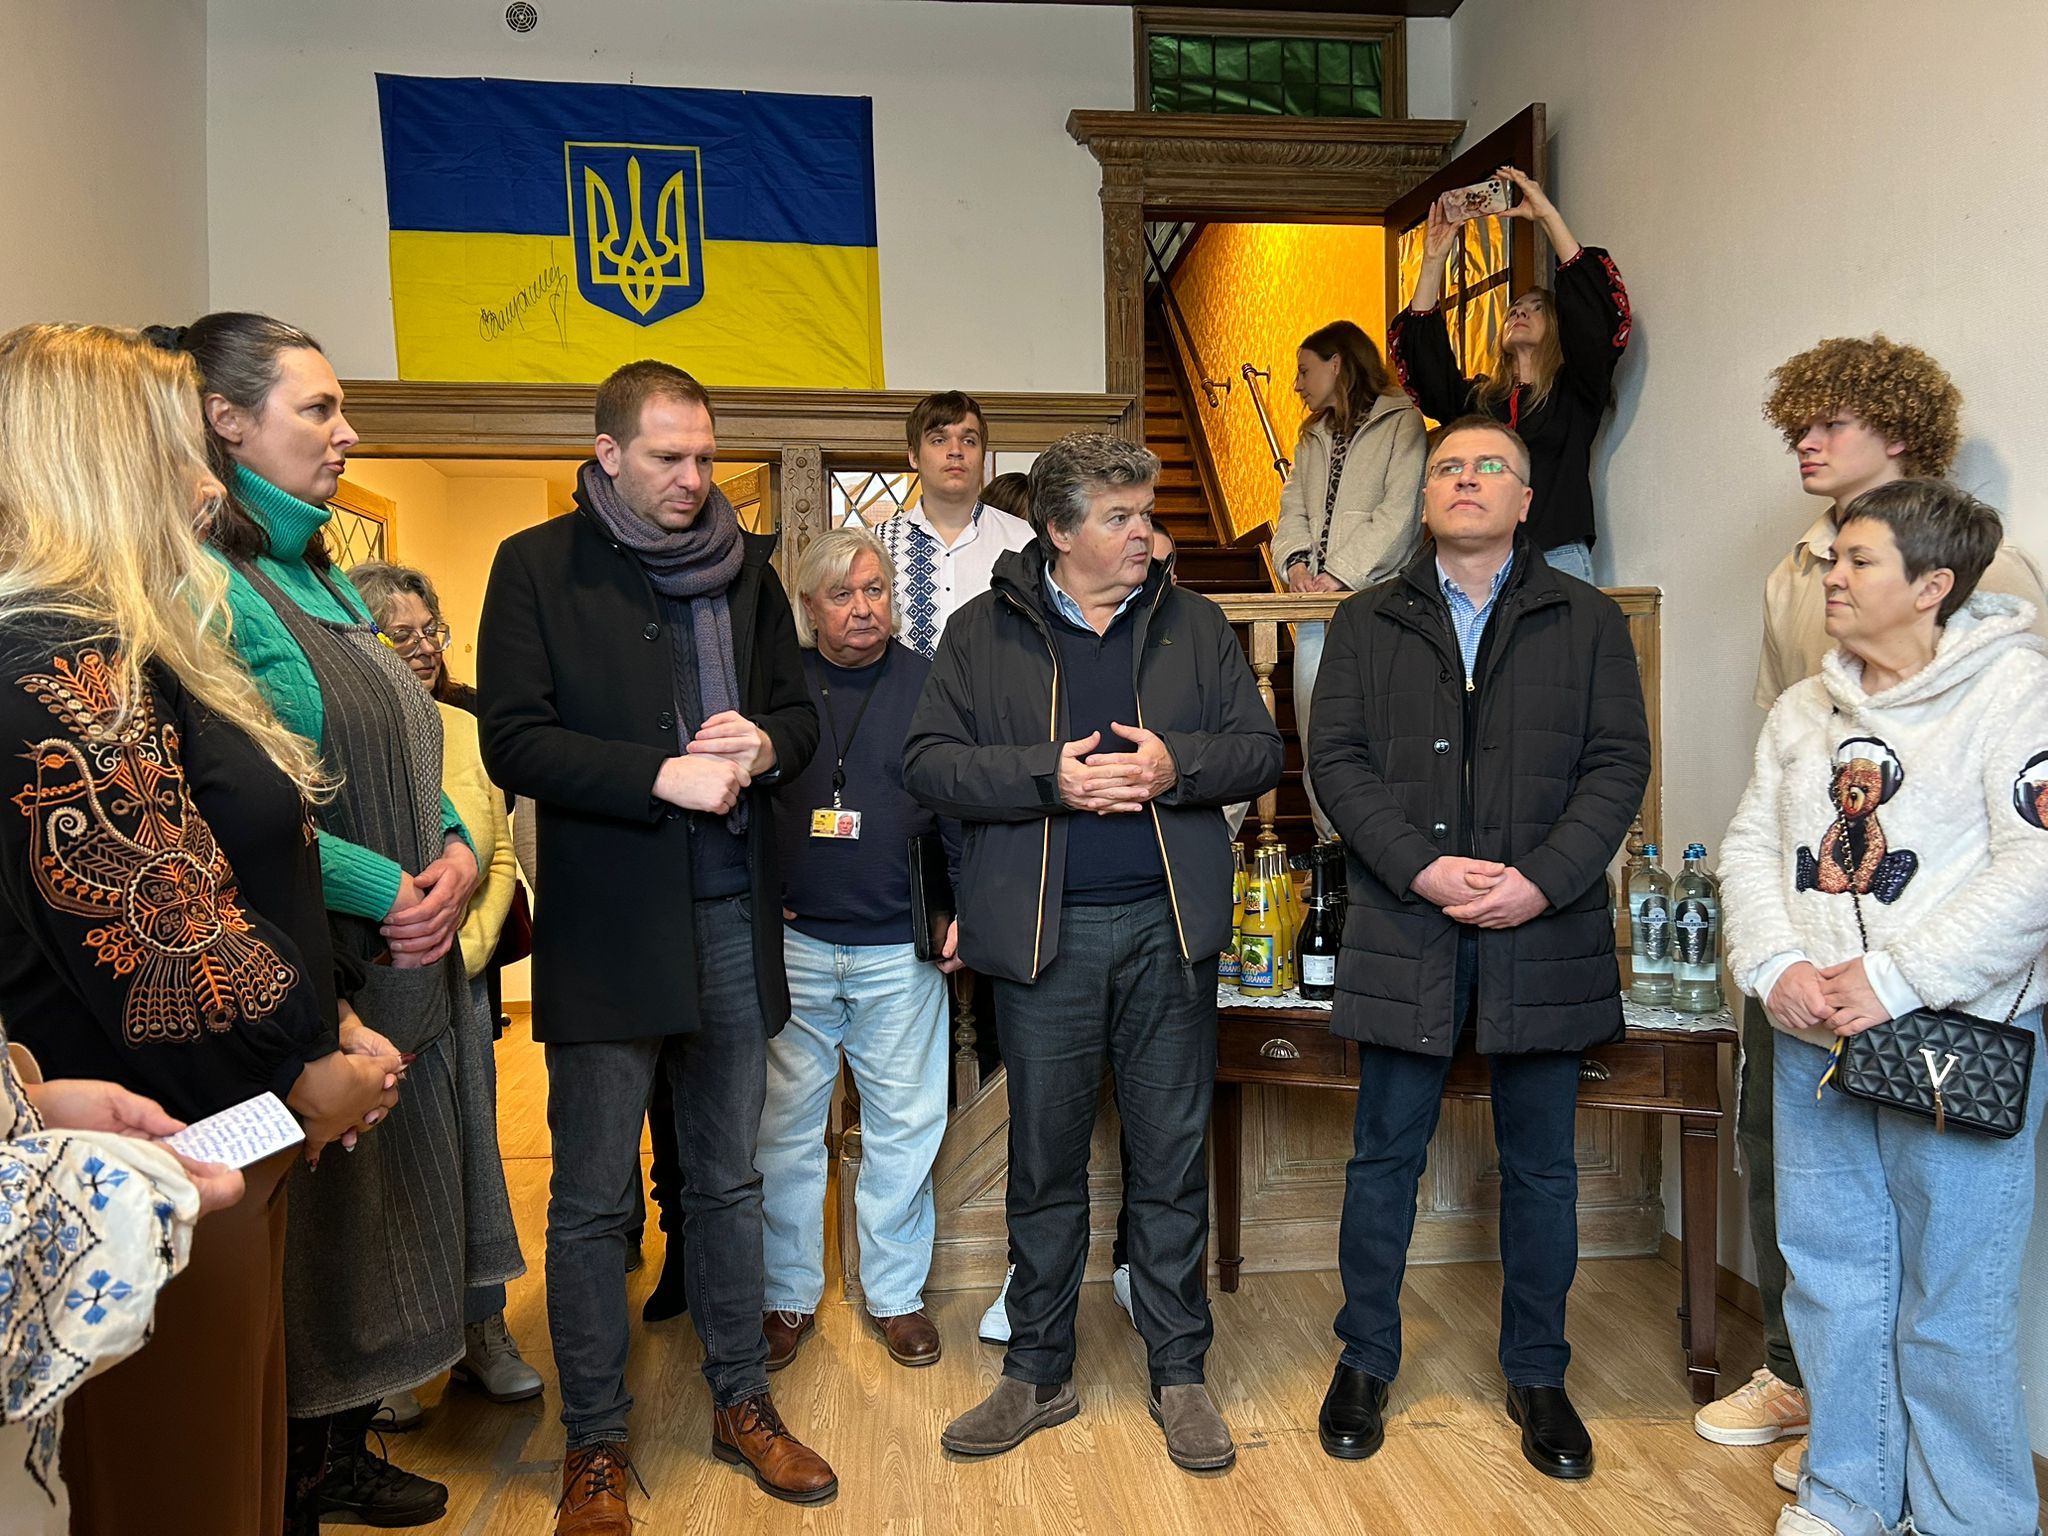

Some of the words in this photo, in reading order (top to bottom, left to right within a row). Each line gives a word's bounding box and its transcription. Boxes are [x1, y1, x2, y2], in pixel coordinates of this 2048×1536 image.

[1218, 965, 1241, 973] ORANG
[1244, 975, 1272, 984] ORANGE
[1918, 1048, 1960, 1090] V
